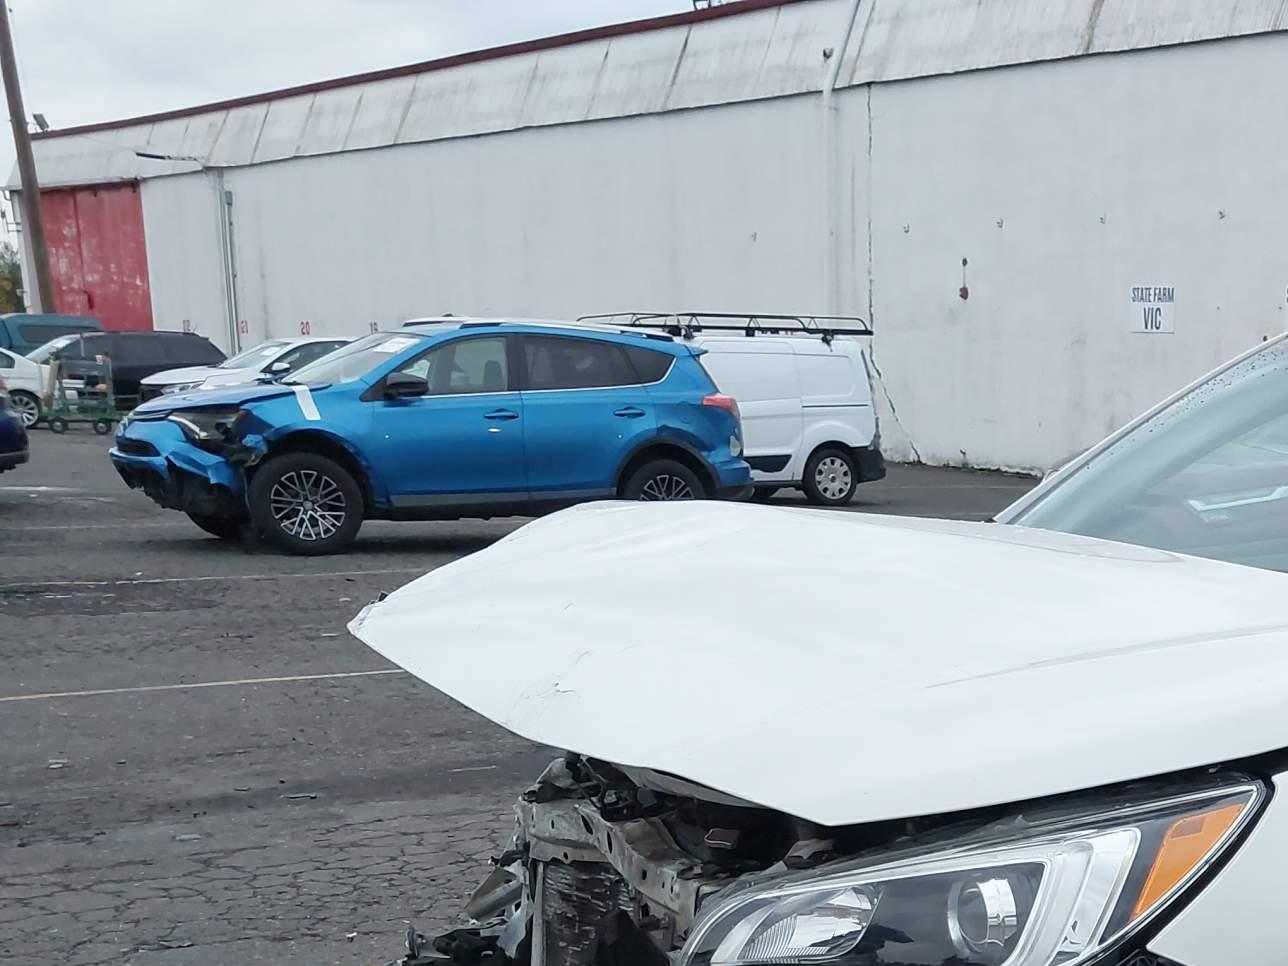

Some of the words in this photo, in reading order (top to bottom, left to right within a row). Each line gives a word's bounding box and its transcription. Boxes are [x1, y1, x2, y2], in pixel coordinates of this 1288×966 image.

[1132, 287, 1151, 302] STATE
[1153, 287, 1174, 302] FARM
[1143, 307, 1161, 330] VIC
[300, 321, 310, 335] 20
